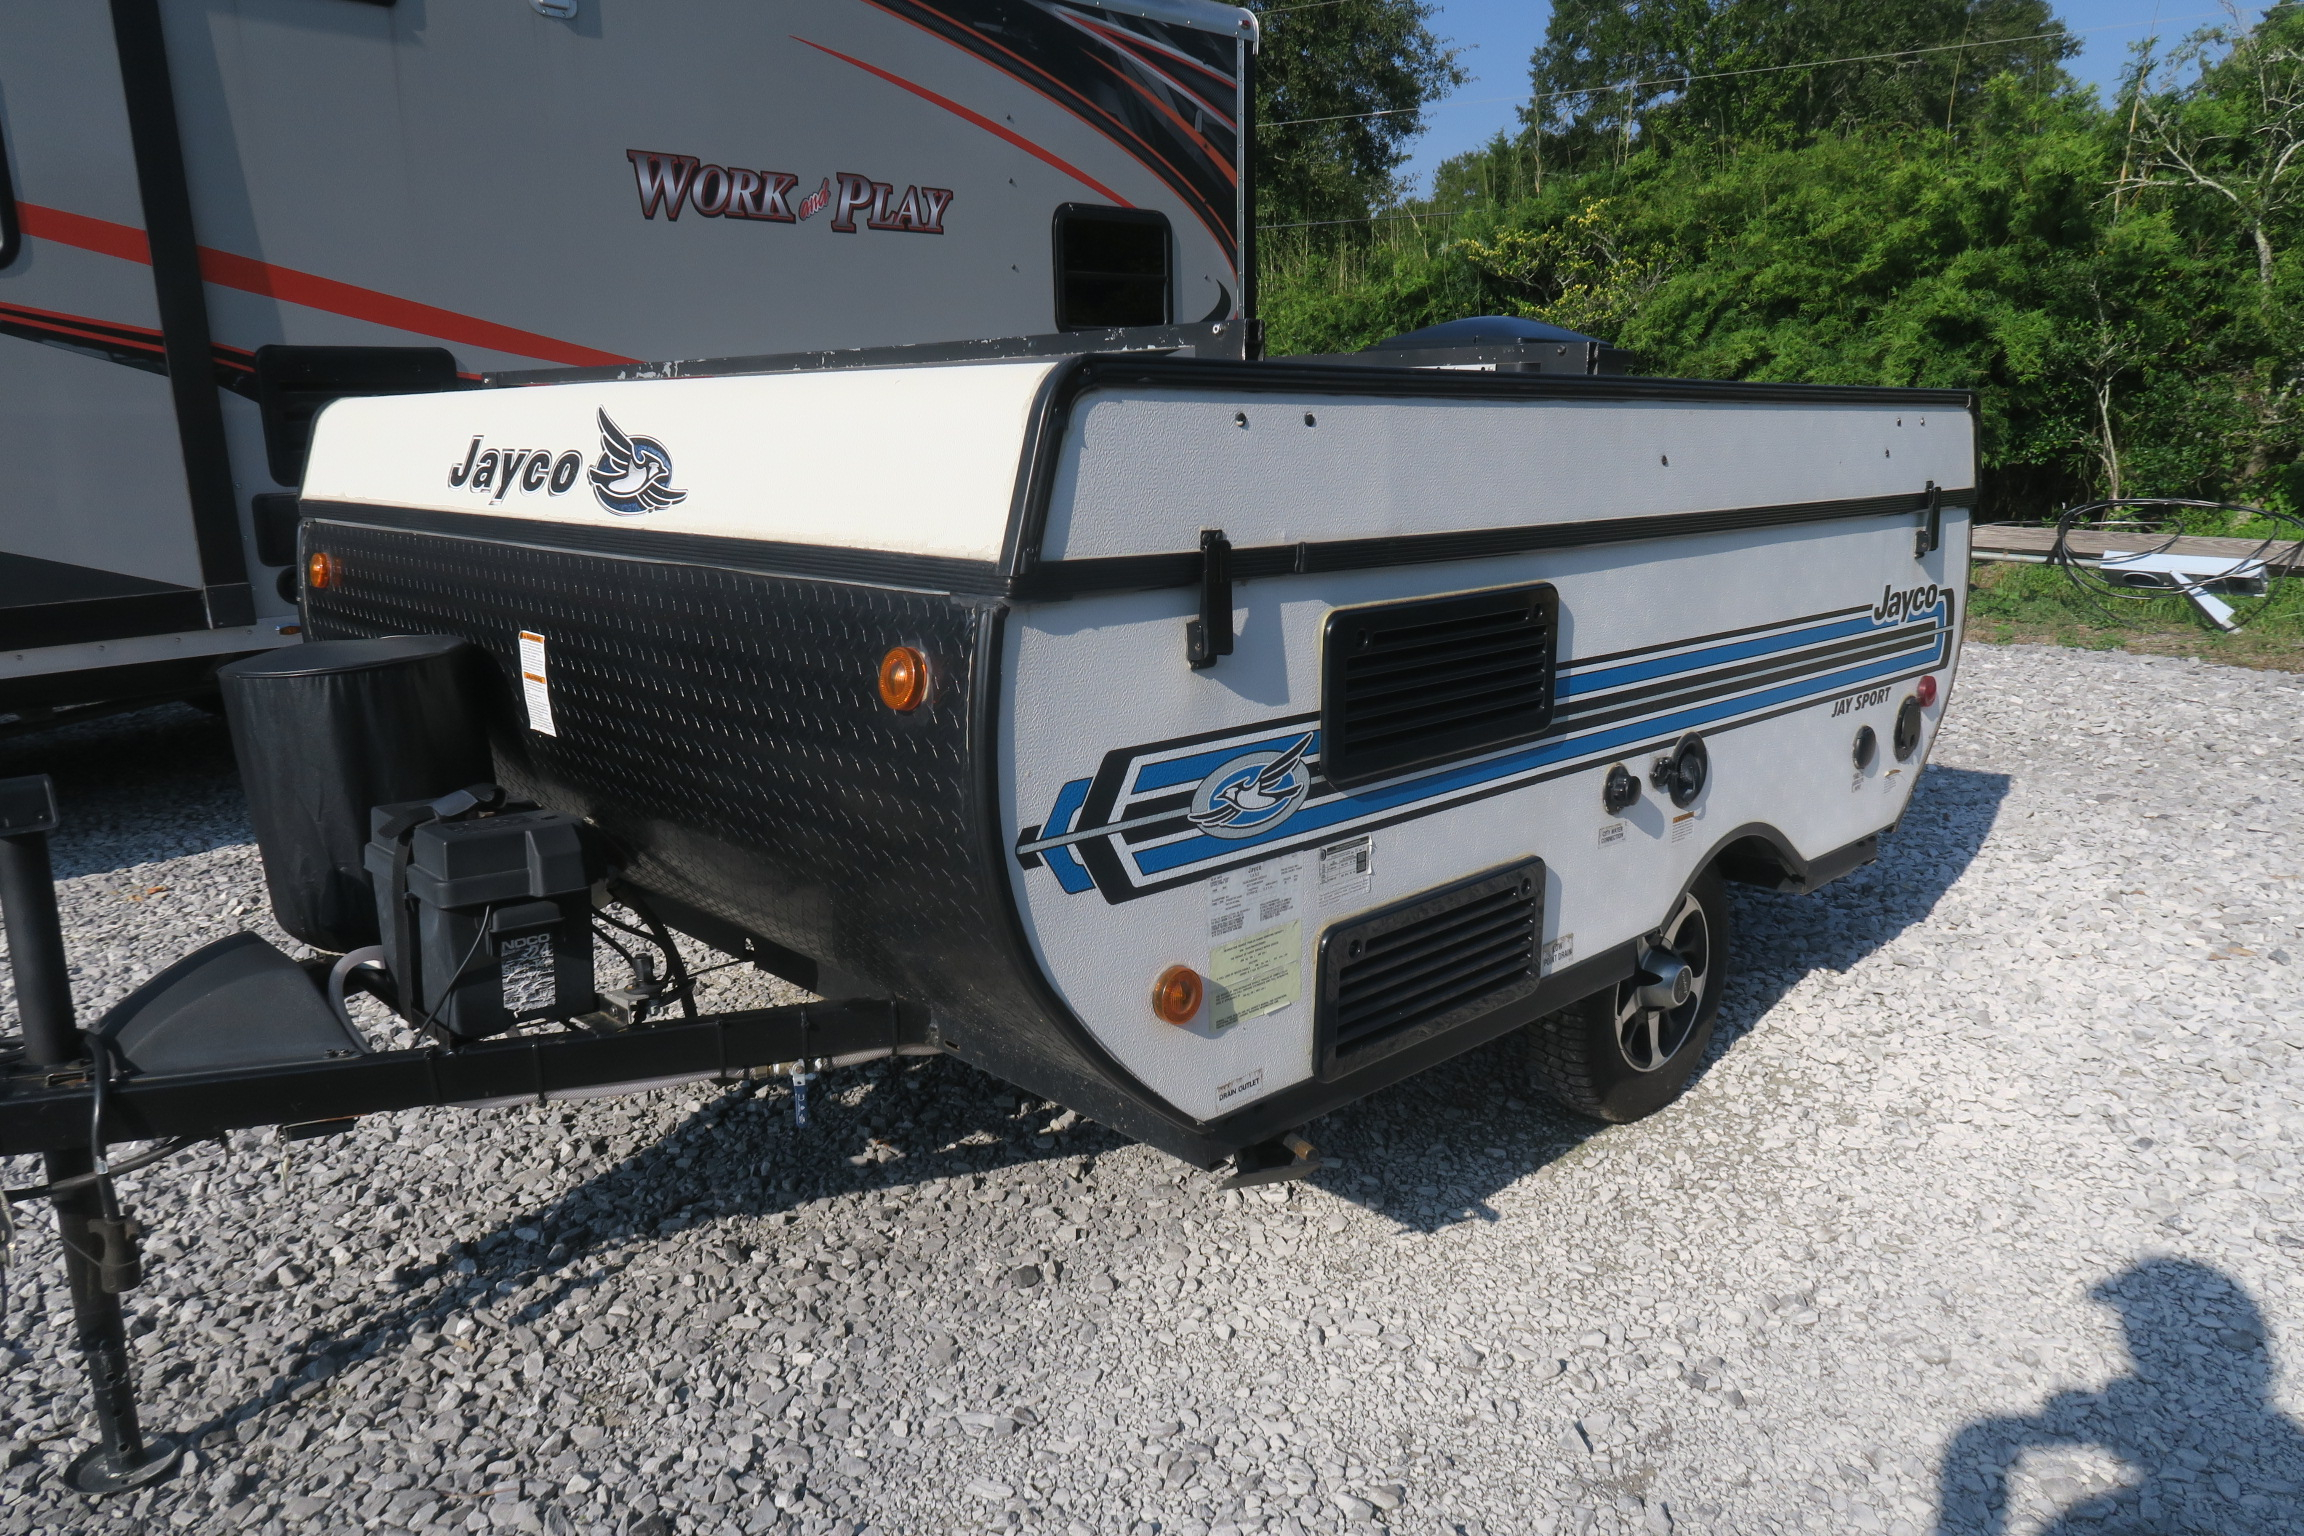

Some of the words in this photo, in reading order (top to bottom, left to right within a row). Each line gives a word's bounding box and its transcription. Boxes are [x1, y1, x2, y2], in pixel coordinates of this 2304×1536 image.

[627, 149, 798, 224] WORK
[799, 178, 831, 221] and
[831, 172, 953, 235] PLAY
[448, 434, 583, 505] Jayco
[1873, 584, 1938, 623] Jayco
[1831, 697, 1854, 718] JAY
[1854, 687, 1892, 711] SPORT
[501, 933, 551, 951] NOCO
[1219, 1088, 1236, 1101] DRAIN
[1238, 1078, 1259, 1092] OUTLET
